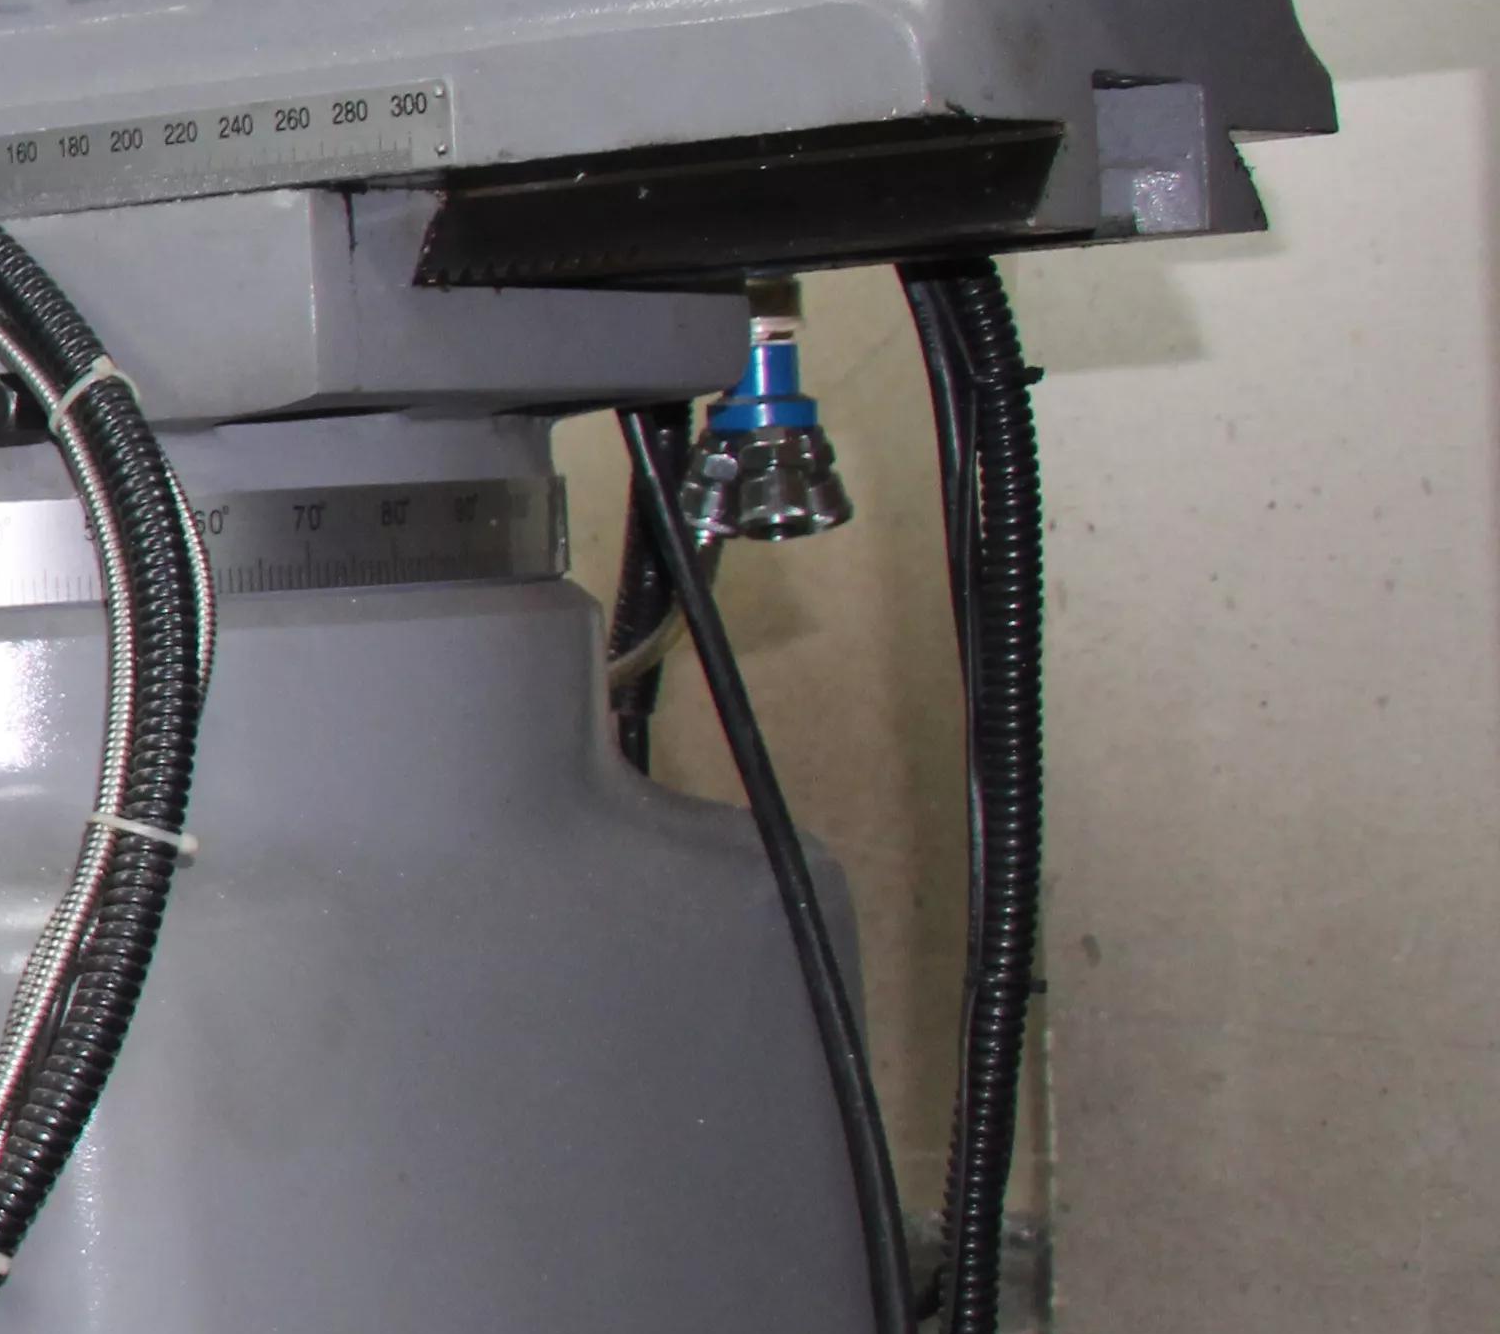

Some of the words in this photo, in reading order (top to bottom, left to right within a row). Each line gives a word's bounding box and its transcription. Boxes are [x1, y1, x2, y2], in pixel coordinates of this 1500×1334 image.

[6, 140, 38, 164] 160
[58, 134, 90, 158] 180
[110, 127, 144, 153] 200
[163, 120, 198, 146] 220
[218, 113, 254, 140] 240
[274, 106, 311, 133] 260
[331, 98, 369, 126] 280
[389, 91, 428, 118] 300
